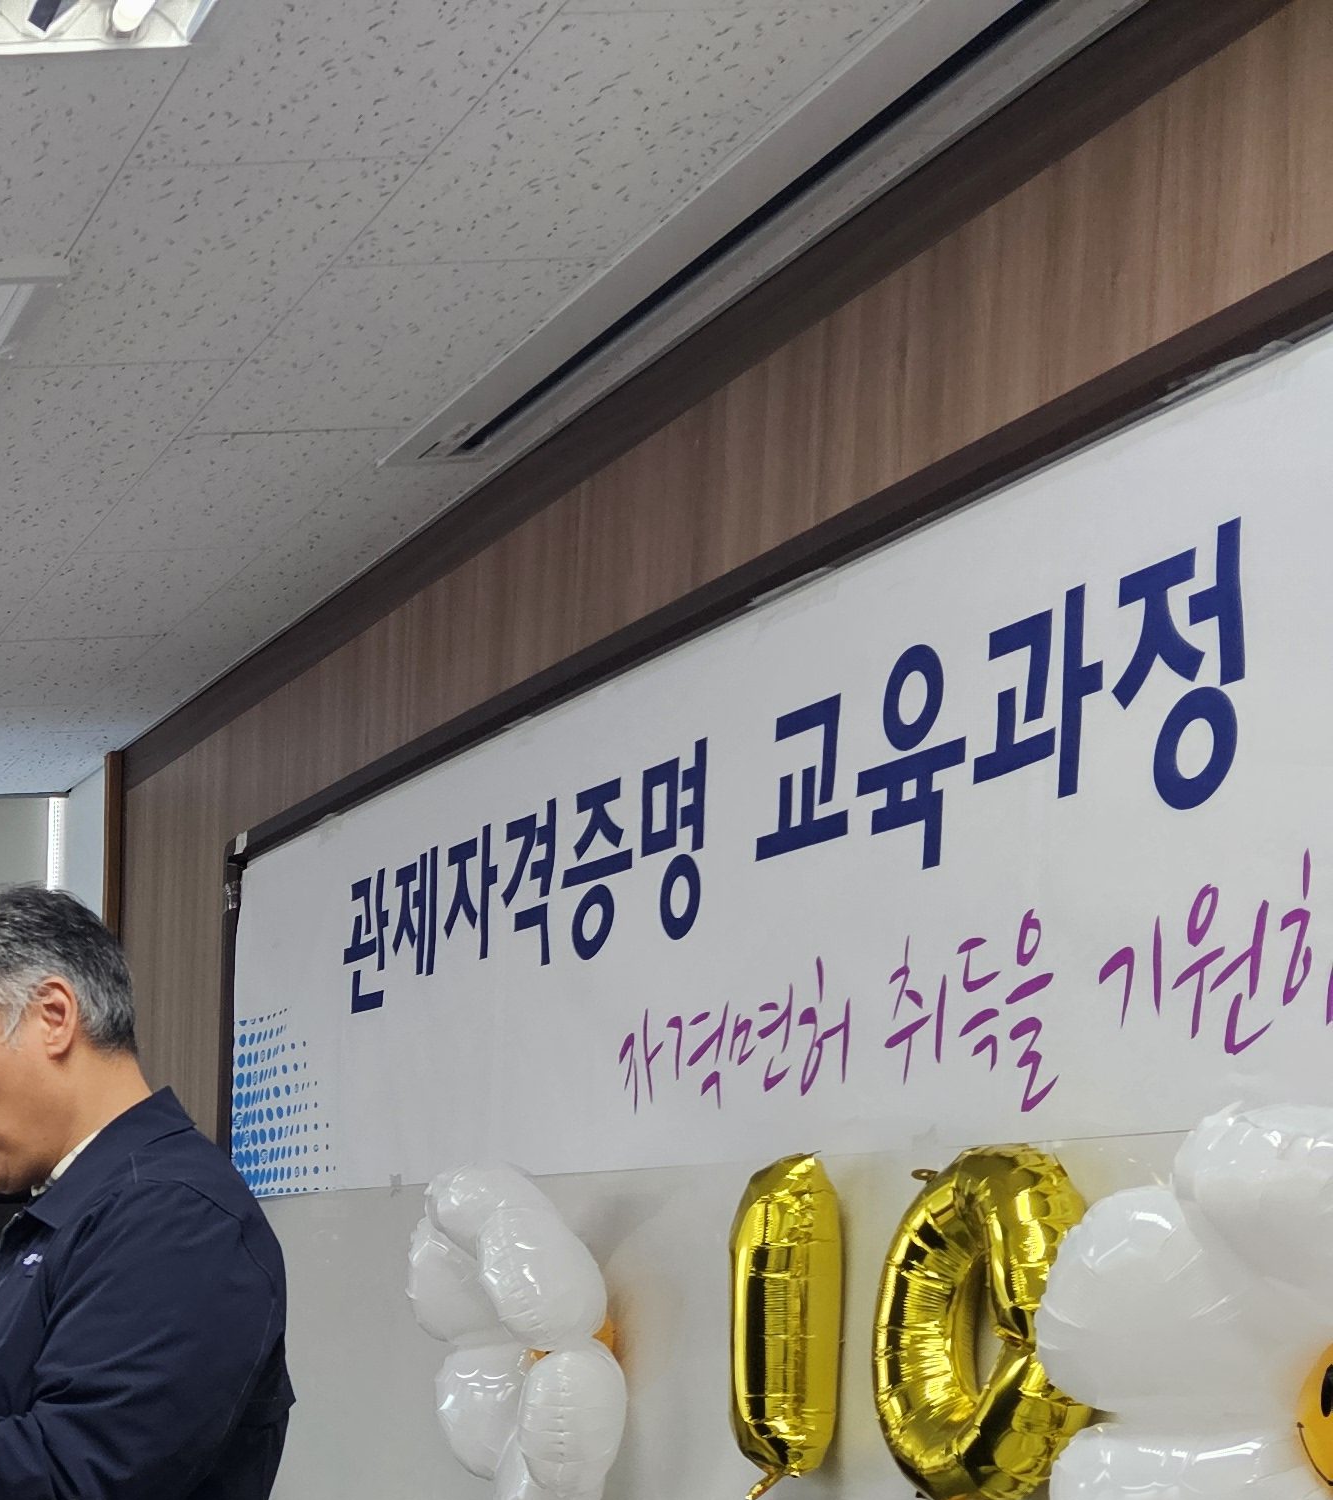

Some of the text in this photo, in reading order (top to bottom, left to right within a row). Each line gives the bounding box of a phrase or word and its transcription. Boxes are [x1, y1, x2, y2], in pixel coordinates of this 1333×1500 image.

[342, 516, 1247, 1015] 관제자격증명 교육과정
[619, 955, 852, 1114] 자격면허
[884, 908, 1059, 1113] 취득을
